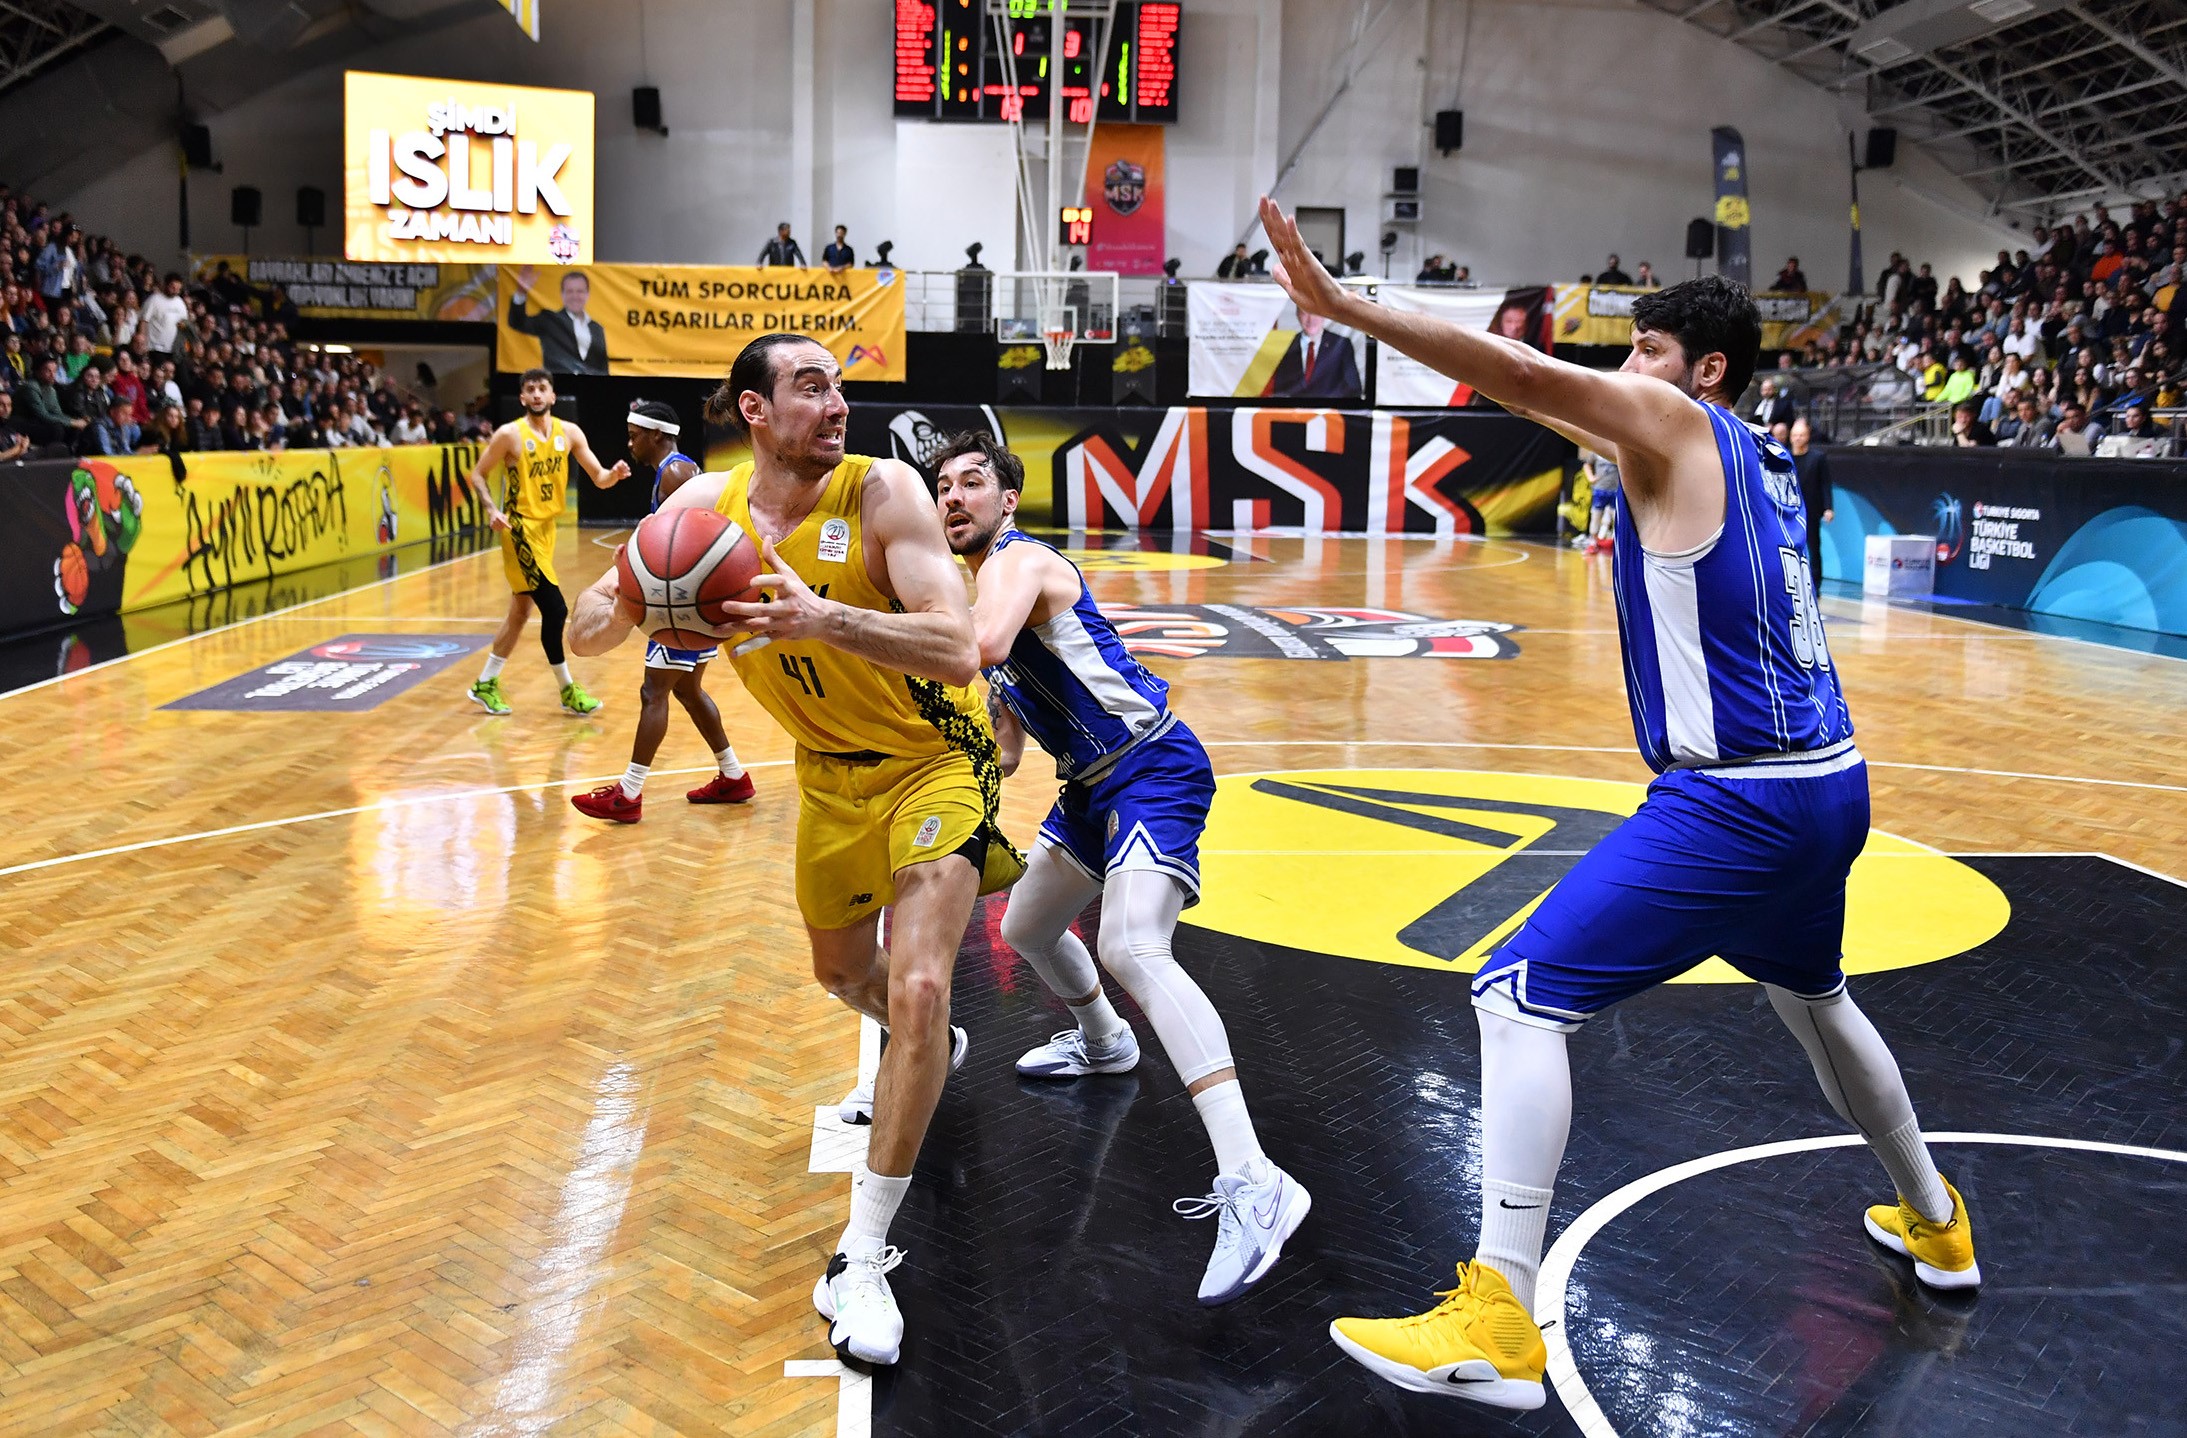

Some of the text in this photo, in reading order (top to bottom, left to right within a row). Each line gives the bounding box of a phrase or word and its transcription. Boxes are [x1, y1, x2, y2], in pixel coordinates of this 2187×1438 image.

[428, 96, 516, 136] ŞİMDİ
[1070, 97, 1093, 123] 10
[369, 128, 573, 216] ISLIK
[387, 209, 512, 245] ZAMANI
[1070, 221, 1090, 244] 14
[639, 276, 851, 302] TÜM SPORCULARA
[627, 309, 863, 332] BAŞARILAR DİLERİM.
[1066, 406, 1473, 534] MSK
[1972, 519, 2019, 540] TÜRKİYE
[1970, 536, 2037, 559] BASKETBOL
[778, 653, 826, 698] 41
